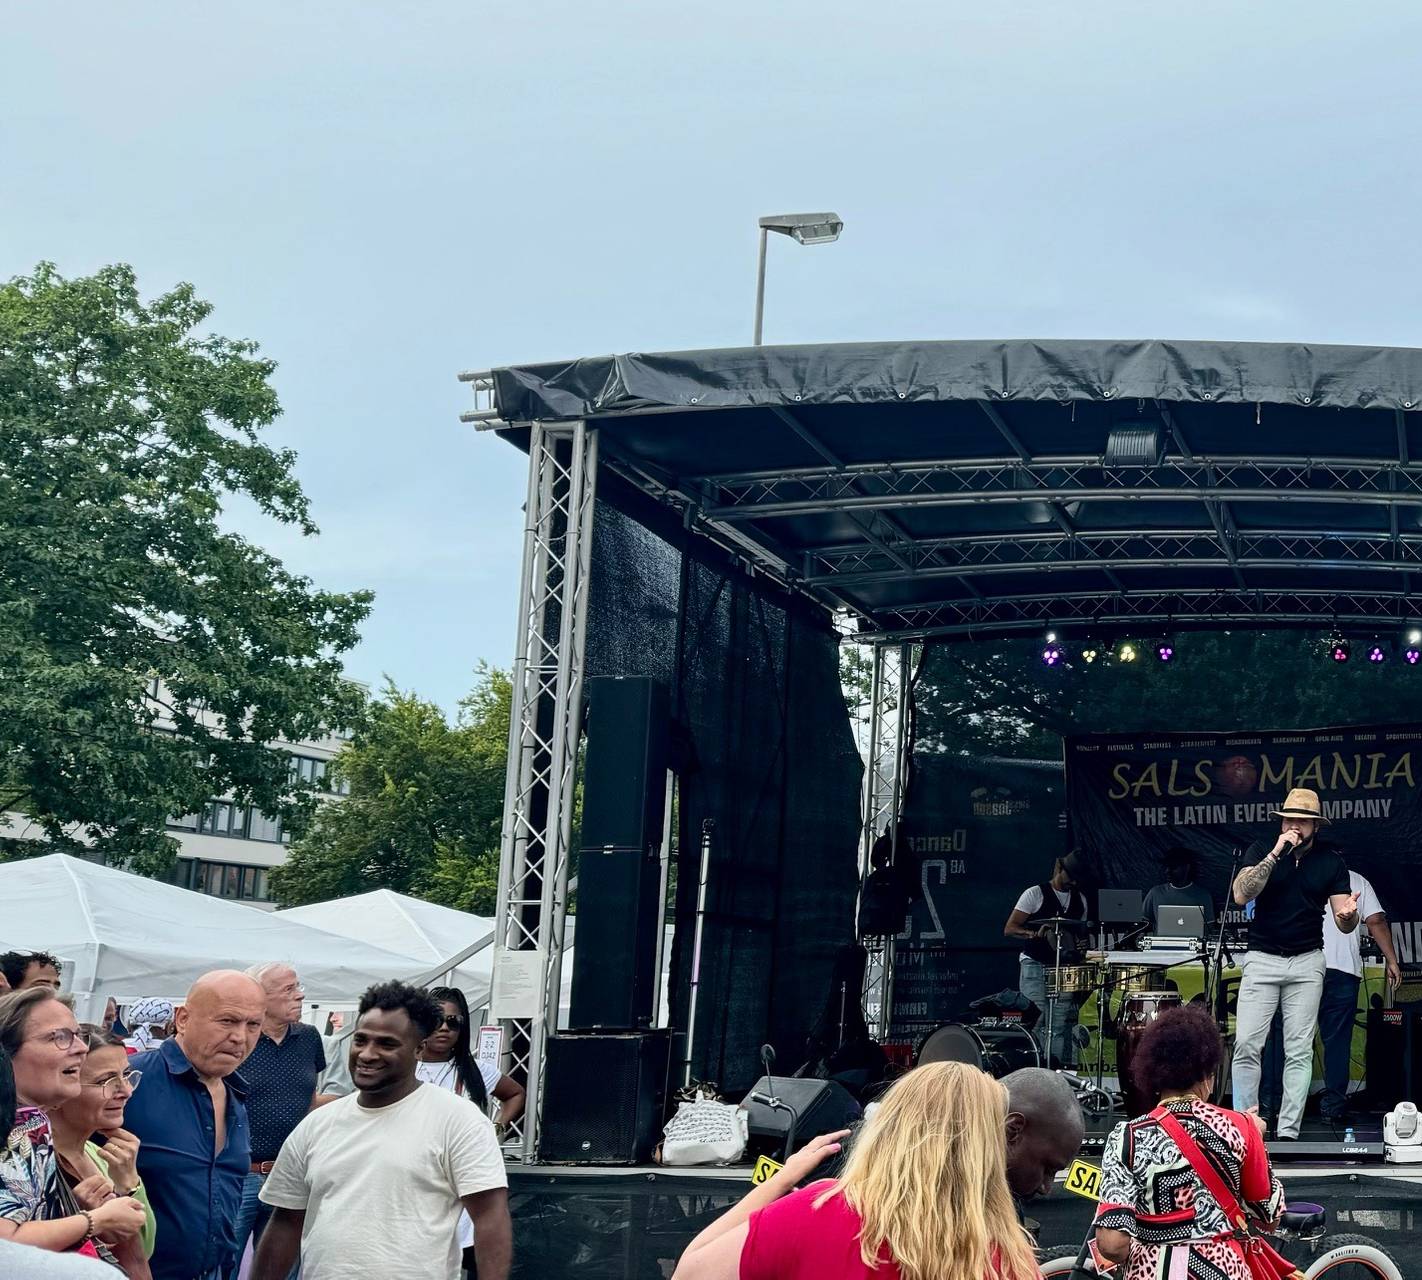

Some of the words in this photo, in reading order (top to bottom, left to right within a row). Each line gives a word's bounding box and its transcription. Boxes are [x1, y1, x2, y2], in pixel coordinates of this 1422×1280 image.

[1108, 759, 1213, 799] SALS
[1258, 752, 1416, 792] MANIA
[1134, 806, 1168, 826] THE
[1174, 804, 1227, 825] LATIN
[1234, 802, 1282, 823] EVEN
[1320, 799, 1392, 820] MPANY
[1071, 1166, 1100, 1197] SA
